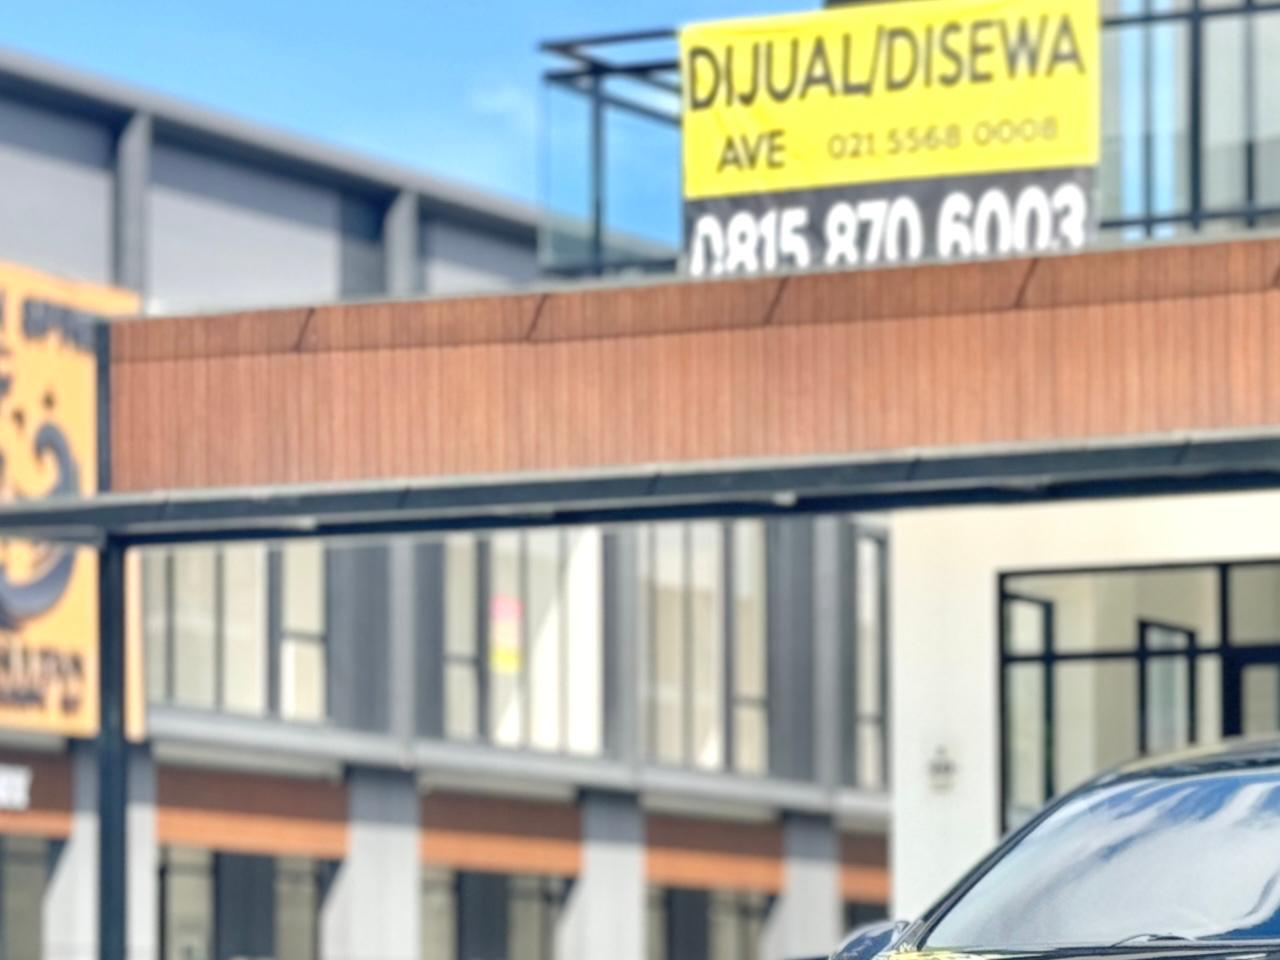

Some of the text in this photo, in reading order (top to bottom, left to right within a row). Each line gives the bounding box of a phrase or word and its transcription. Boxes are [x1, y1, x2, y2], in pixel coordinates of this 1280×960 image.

[689, 15, 1085, 111] DIJUAL/DISEWA
[716, 116, 1057, 173] AVE 021 5568 0008
[690, 210, 811, 277] 0815
[824, 197, 923, 263] 870
